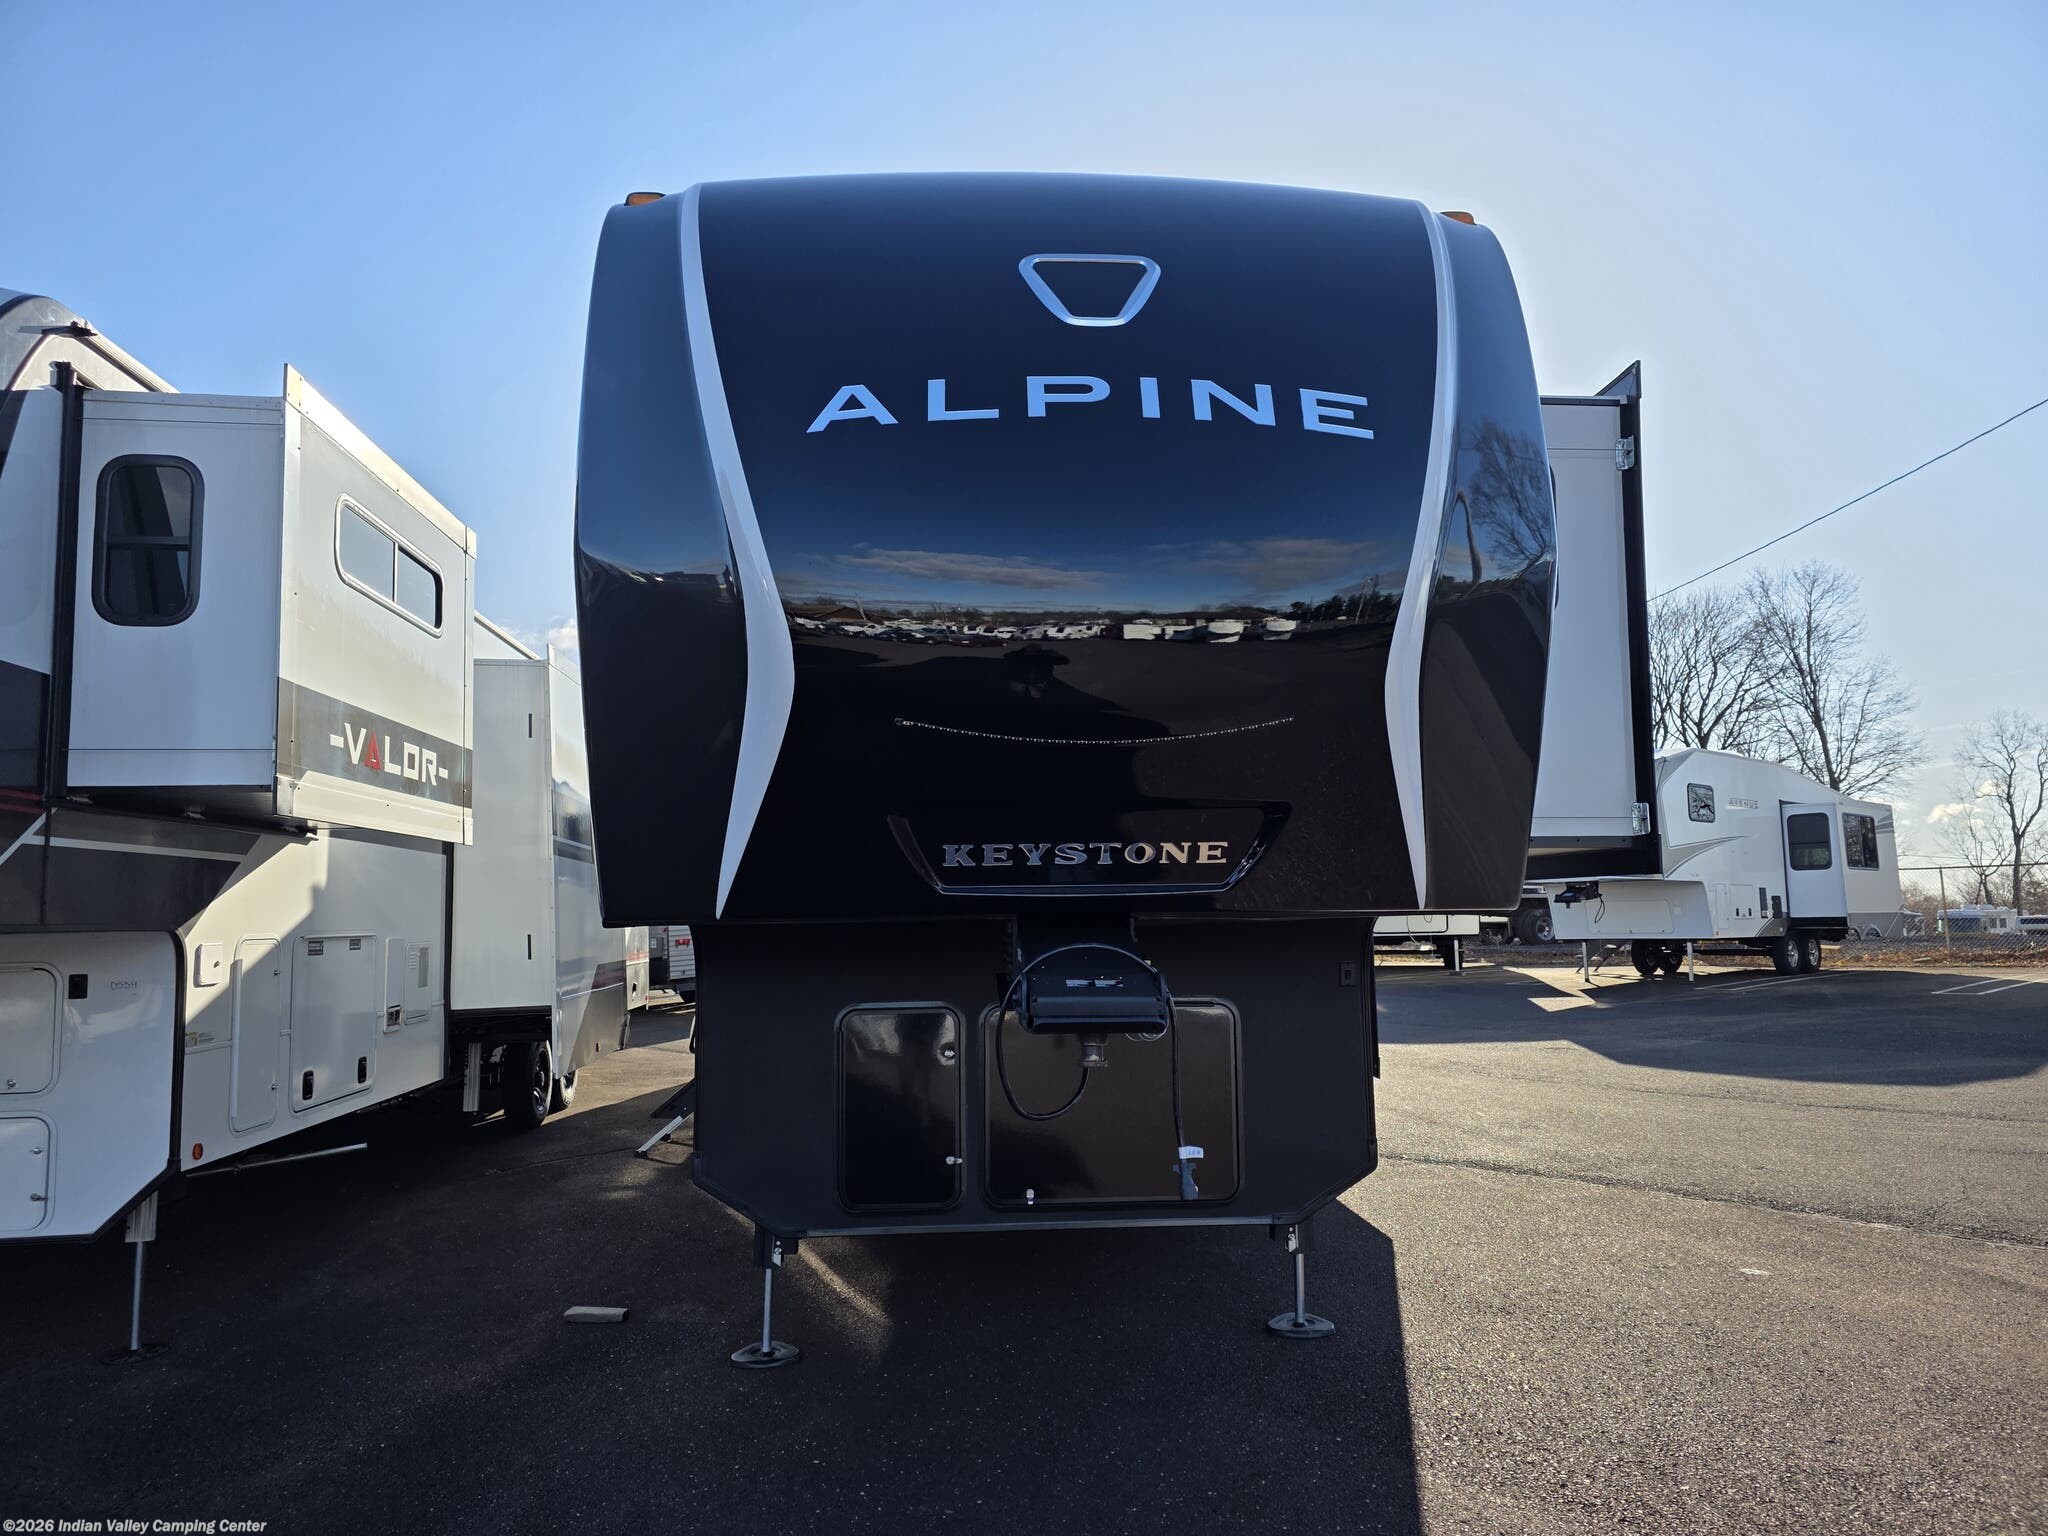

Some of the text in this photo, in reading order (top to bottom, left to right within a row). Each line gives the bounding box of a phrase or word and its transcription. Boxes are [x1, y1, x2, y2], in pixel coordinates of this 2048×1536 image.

[806, 376, 1374, 439] ALPINE
[1728, 797, 1760, 809] AVENUE
[942, 841, 1229, 867] KEYSTONE
